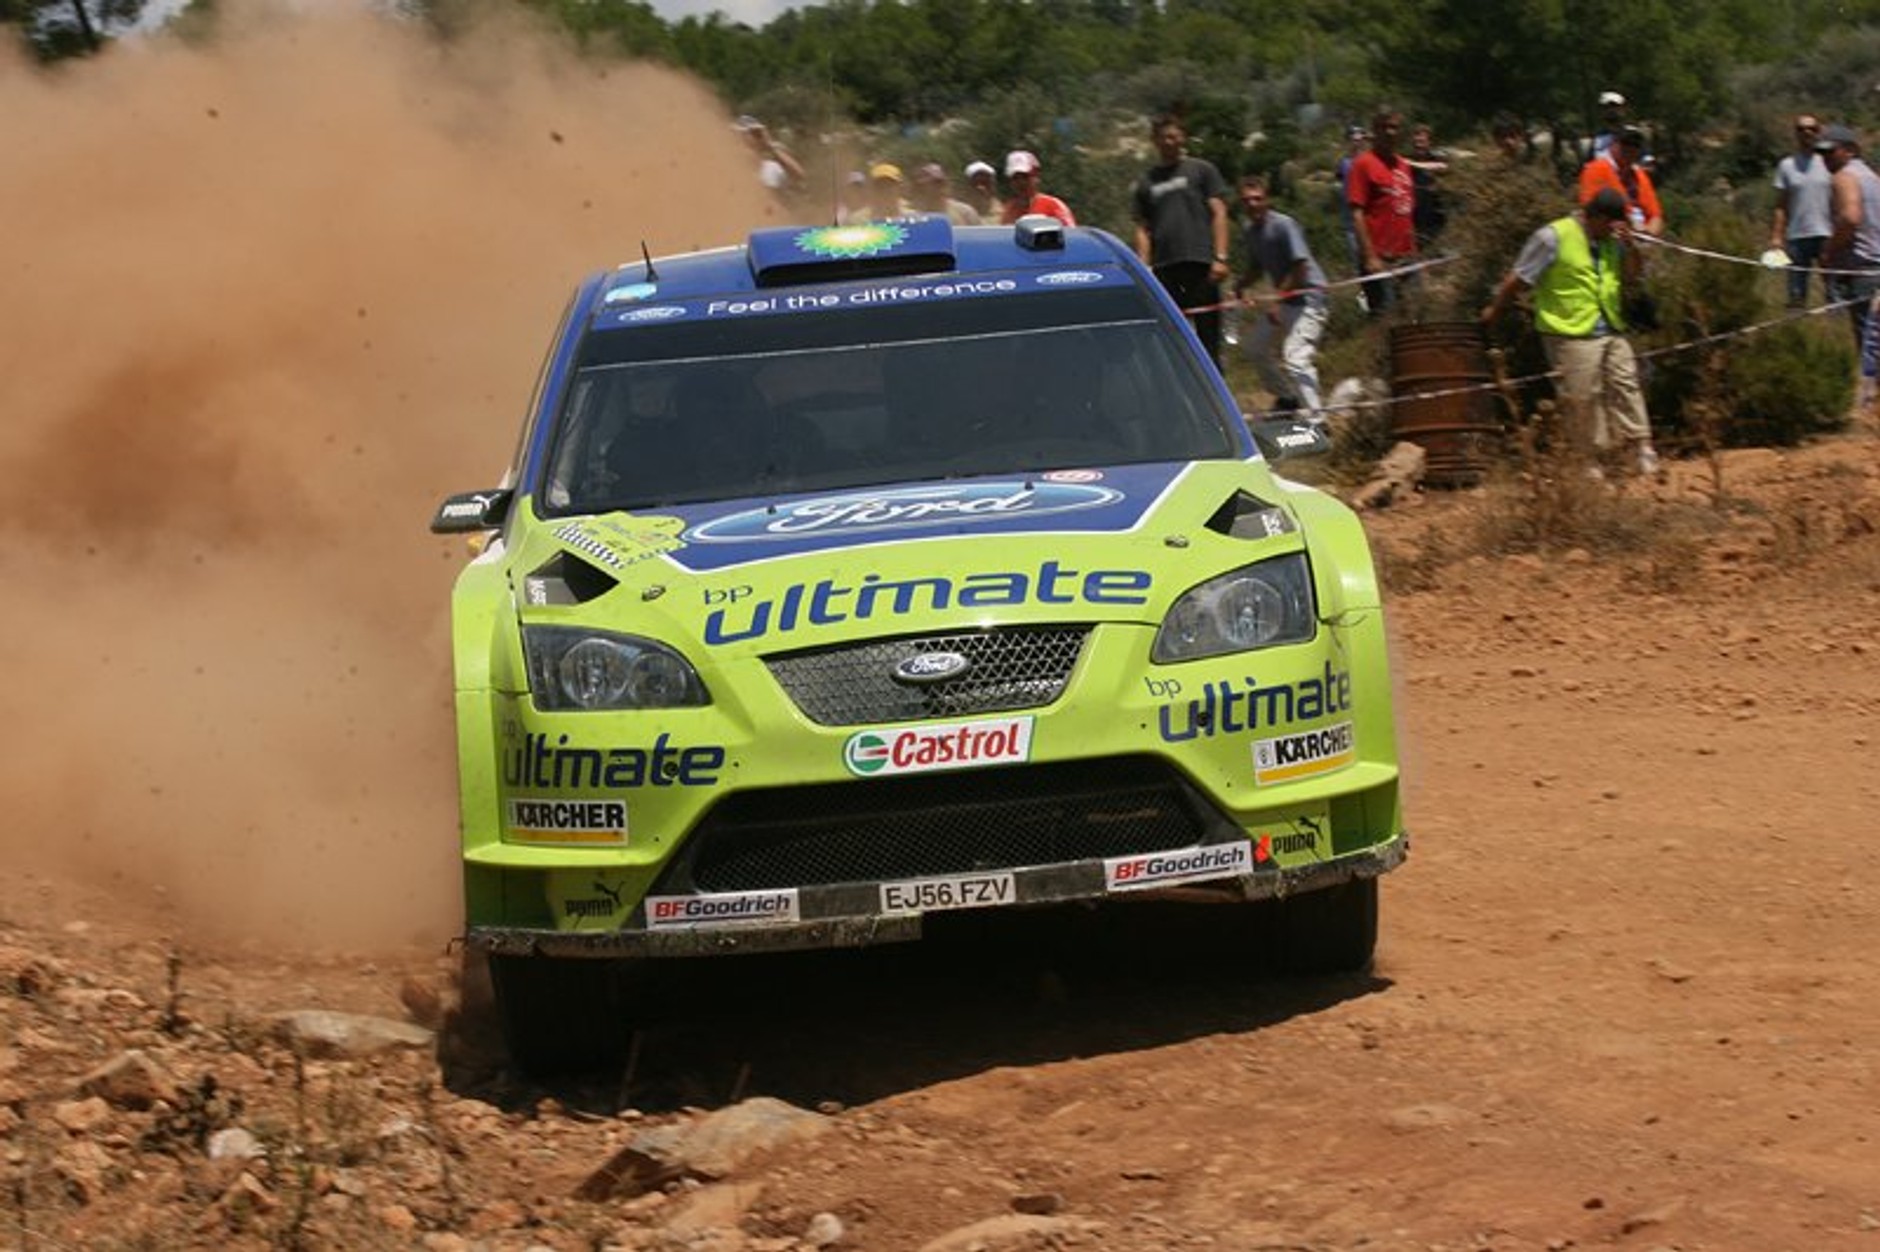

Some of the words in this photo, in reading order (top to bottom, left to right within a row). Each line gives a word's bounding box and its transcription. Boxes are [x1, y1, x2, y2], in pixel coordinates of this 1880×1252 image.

[708, 299, 777, 316] Feel
[787, 294, 840, 311] the
[850, 279, 1016, 304] difference
[766, 487, 1036, 532] Ford
[703, 584, 754, 605] bp
[703, 561, 1152, 645] ultimate
[911, 655, 956, 674] Ford
[1145, 676, 1182, 699] bp
[1159, 660, 1350, 743] ultimate
[504, 732, 725, 788] ultimate
[892, 723, 1019, 768] Castrol
[1115, 847, 1245, 880] BFGoodrich
[655, 895, 791, 918] BFGoodrich
